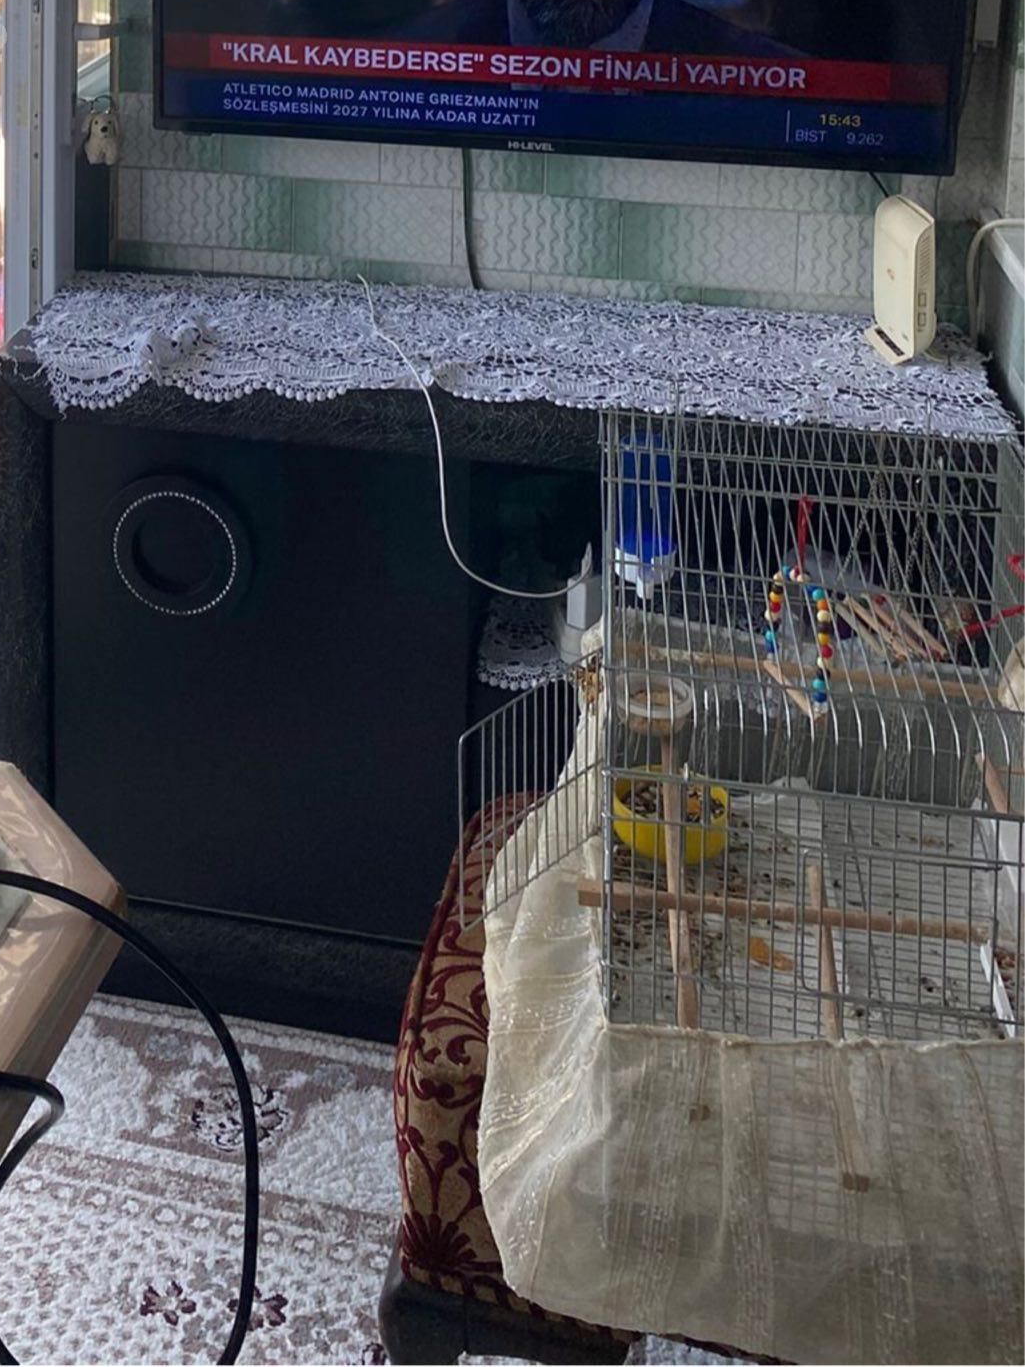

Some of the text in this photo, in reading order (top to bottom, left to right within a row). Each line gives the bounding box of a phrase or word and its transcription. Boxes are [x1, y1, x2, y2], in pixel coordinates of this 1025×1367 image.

[223, 42, 807, 89] "KRAL KAYBEDERSE" SEZON FİNALİ YAPIYOR
[223, 82, 539, 110] ATLETICO MADRID ANTOINE GRIEZMANN'IN
[223, 97, 536, 127] SÖZLEŞMESİNİ 2027 YILINA KADAR UZATTI
[819, 113, 862, 128] 15:43
[795, 127, 828, 143] BİST
